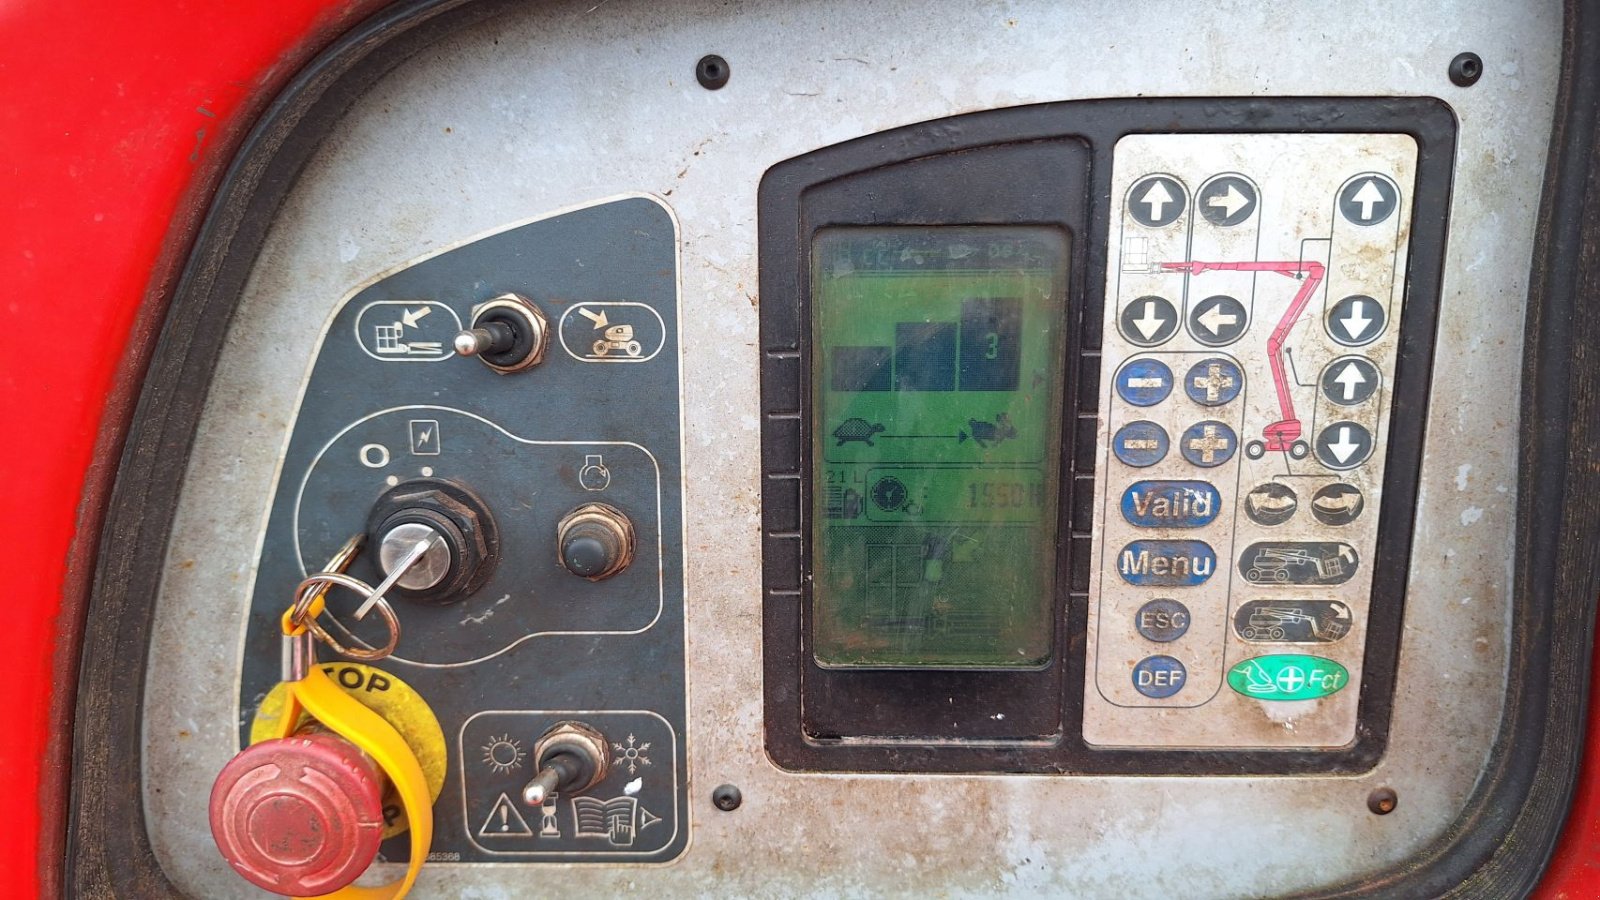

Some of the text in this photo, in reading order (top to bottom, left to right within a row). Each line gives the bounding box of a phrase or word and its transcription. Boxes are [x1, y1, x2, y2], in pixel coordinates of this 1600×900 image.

[985, 332, 999, 360] 3
[1131, 490, 1212, 517] Valid
[1122, 550, 1211, 576] Menu
[1139, 611, 1187, 630] ESC
[1137, 669, 1183, 687] DEF
